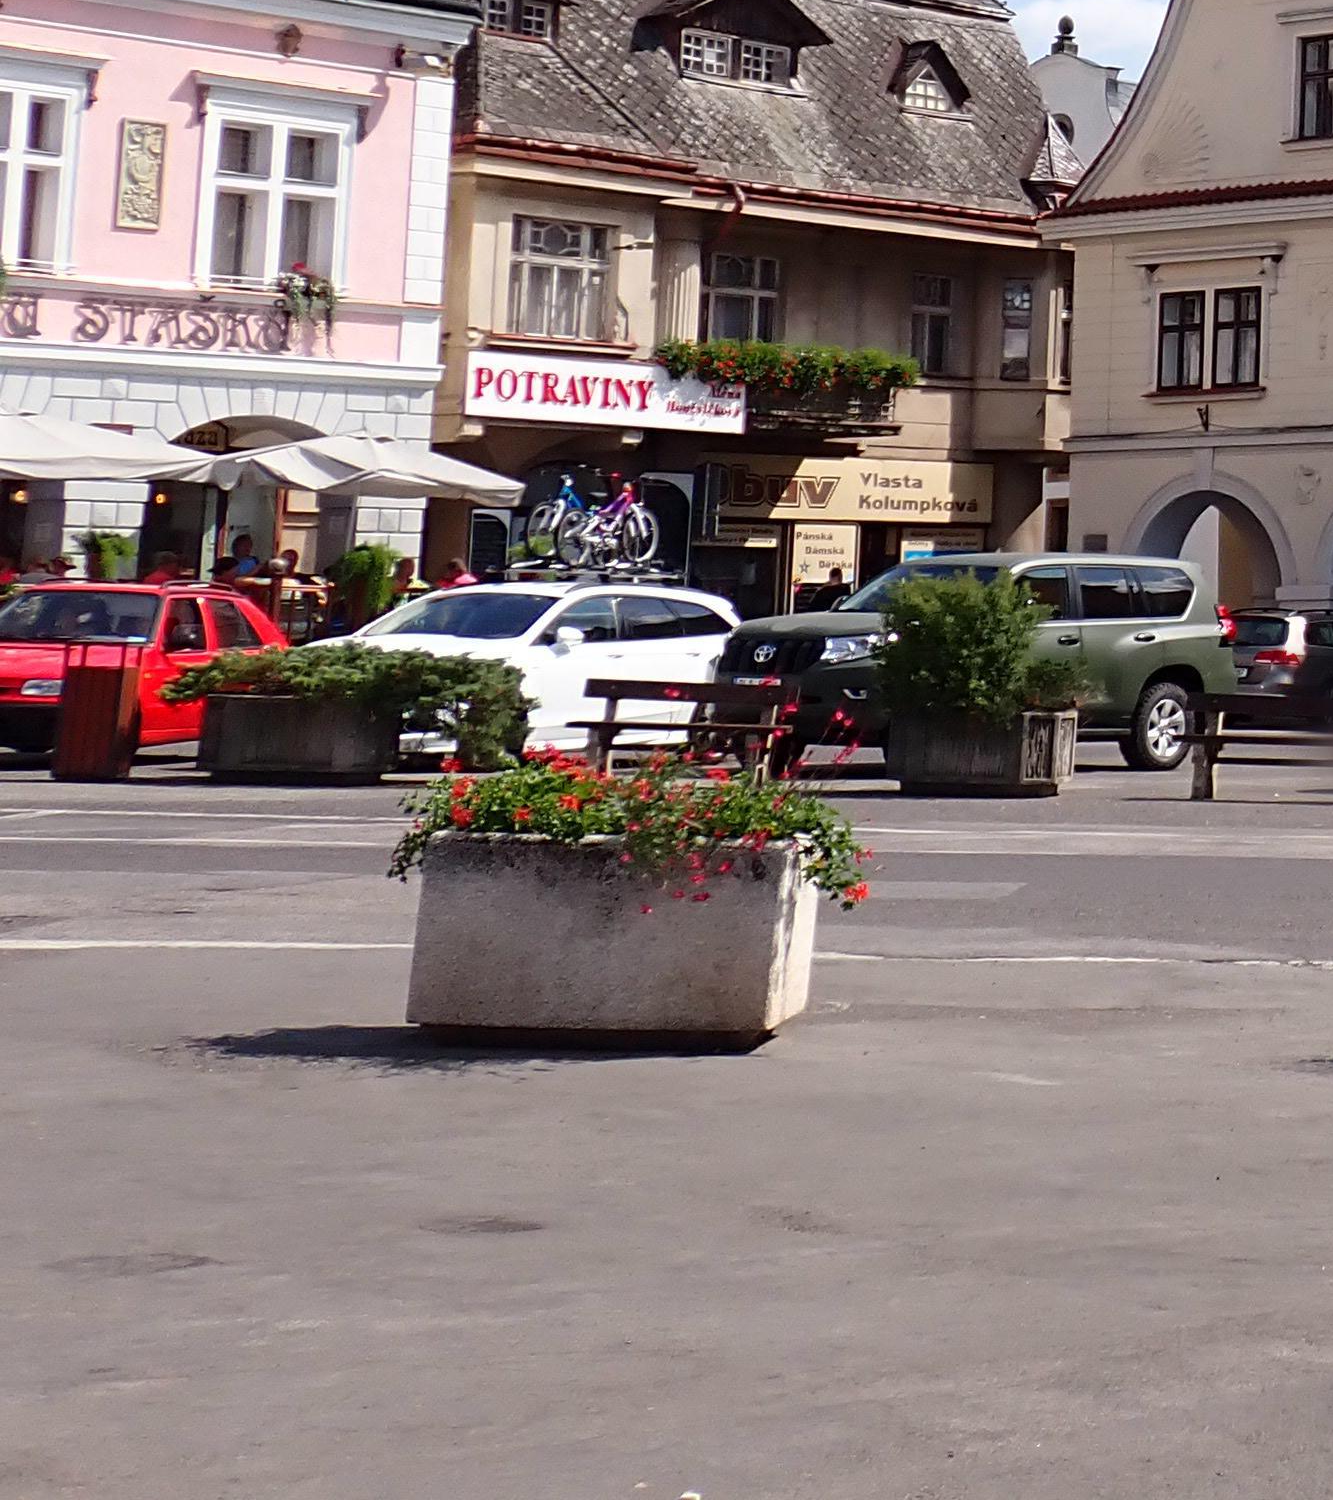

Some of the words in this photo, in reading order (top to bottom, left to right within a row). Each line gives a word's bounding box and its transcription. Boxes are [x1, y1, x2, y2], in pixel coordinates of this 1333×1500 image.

[473, 367, 655, 411] POTRAVINY
[859, 472, 923, 490] Vlasta
[858, 494, 979, 514] Kolumpková
